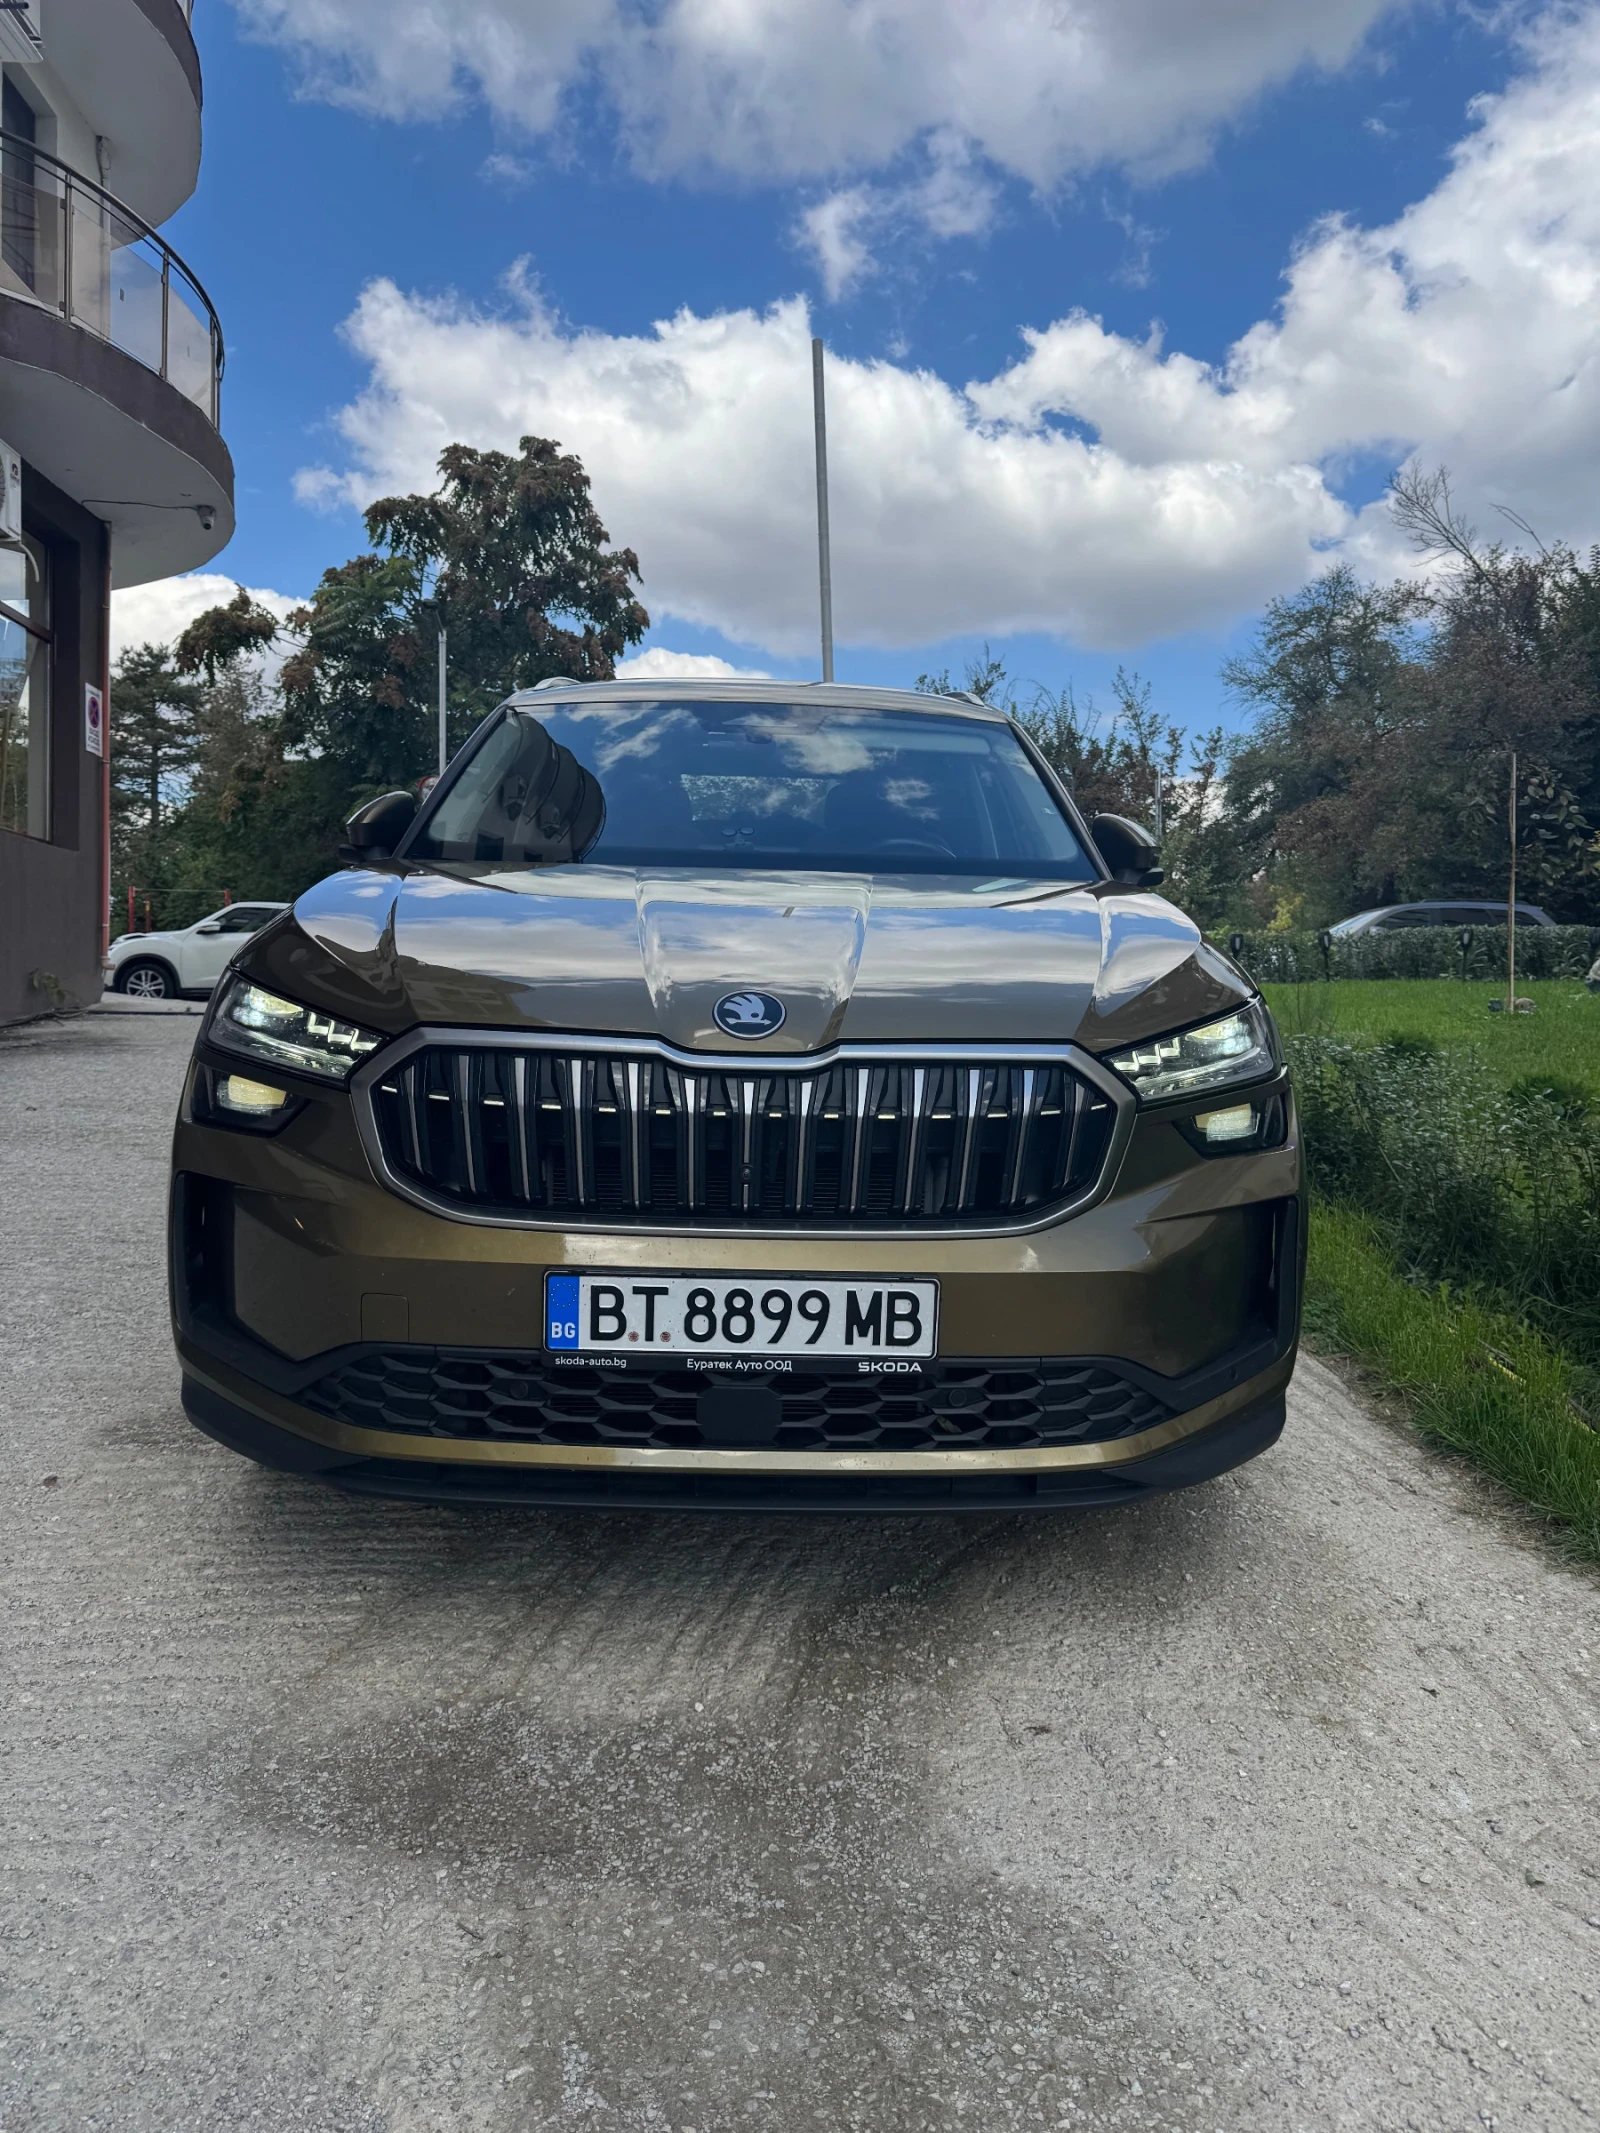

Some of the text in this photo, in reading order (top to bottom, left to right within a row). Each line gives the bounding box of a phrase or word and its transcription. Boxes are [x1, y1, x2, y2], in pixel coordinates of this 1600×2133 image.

[589, 1284, 923, 1347] BT 8899 MB
[551, 1321, 576, 1339] BG
[554, 1356, 627, 1368] skoda-auto.bg
[686, 1358, 793, 1372] Еуратек Ауто ООД
[858, 1361, 923, 1373] SKODA
